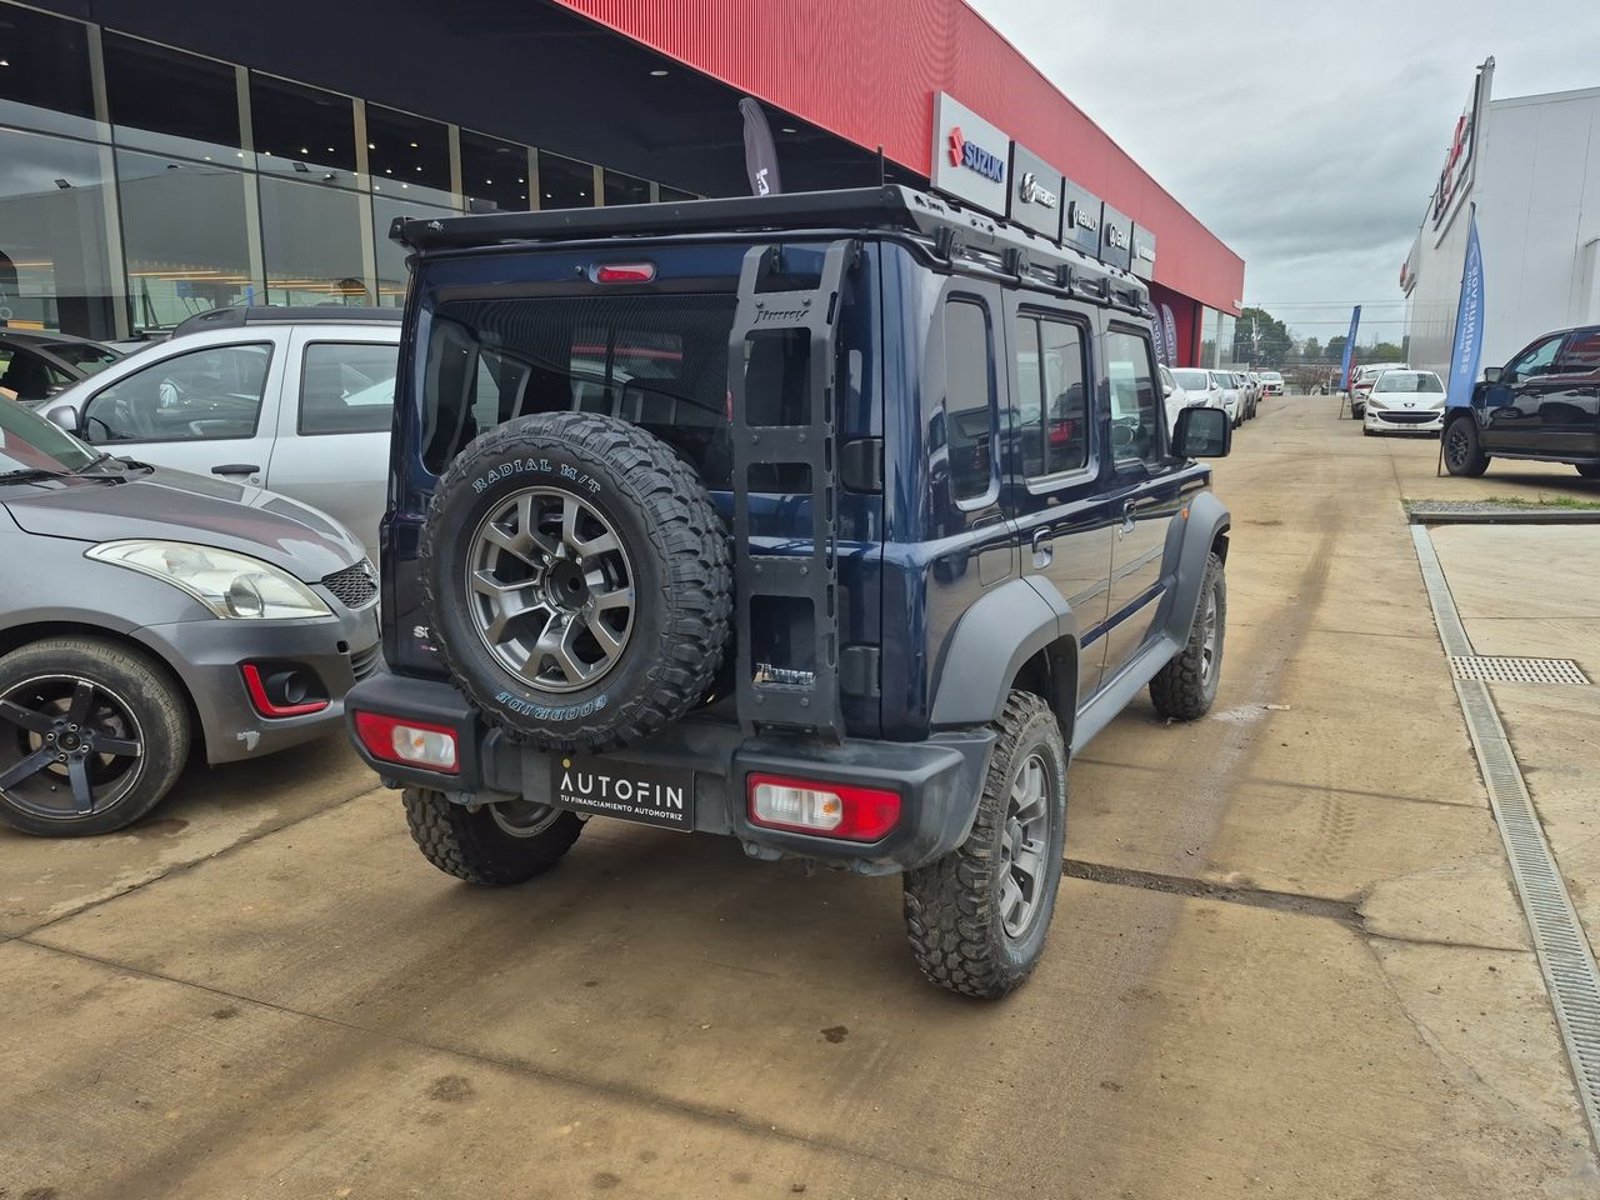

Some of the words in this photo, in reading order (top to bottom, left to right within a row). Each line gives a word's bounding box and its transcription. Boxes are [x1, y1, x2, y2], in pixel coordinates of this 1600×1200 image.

[963, 140, 1003, 183] SUZUKI
[472, 458, 553, 494] RADIAL
[561, 463, 602, 494] M/T
[494, 690, 608, 722] GOODRIDE
[560, 770, 684, 810] AUTOFIN
[560, 794, 570, 802] TU
[571, 795, 633, 812] FINANCIAMIENTO
[634, 806, 684, 821] AUTOMOTRIZ
